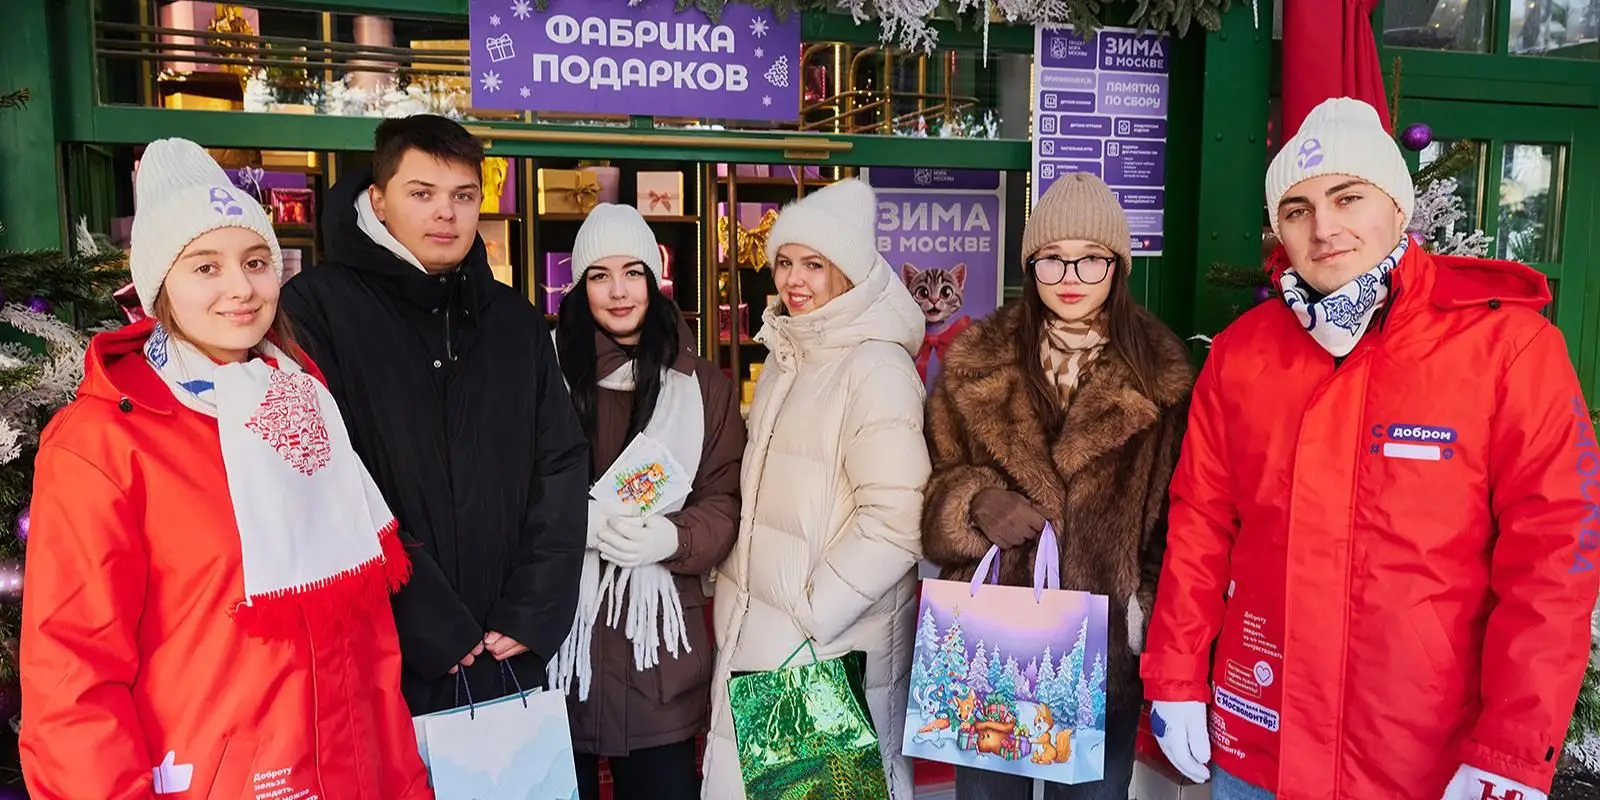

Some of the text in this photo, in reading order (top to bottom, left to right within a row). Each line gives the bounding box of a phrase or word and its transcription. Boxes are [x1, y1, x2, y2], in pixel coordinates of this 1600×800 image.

[545, 14, 735, 53] ФАБРИКА
[1105, 37, 1164, 57] ЗИМА
[1105, 56, 1164, 69] В МОСКВЕ
[532, 53, 749, 92] ПОДАРКОВ
[1106, 82, 1160, 94] ПАМЯТКА
[1105, 95, 1161, 108] ПО СБОРУ
[877, 202, 991, 232] ЗИМА
[877, 236, 991, 253] В МОСКВЕ
[1393, 426, 1451, 440] добром
[1222, 698, 1276, 729] Мосволонтёр!
[254, 767, 292, 782] Доброту
[254, 779, 286, 791] нельзя
